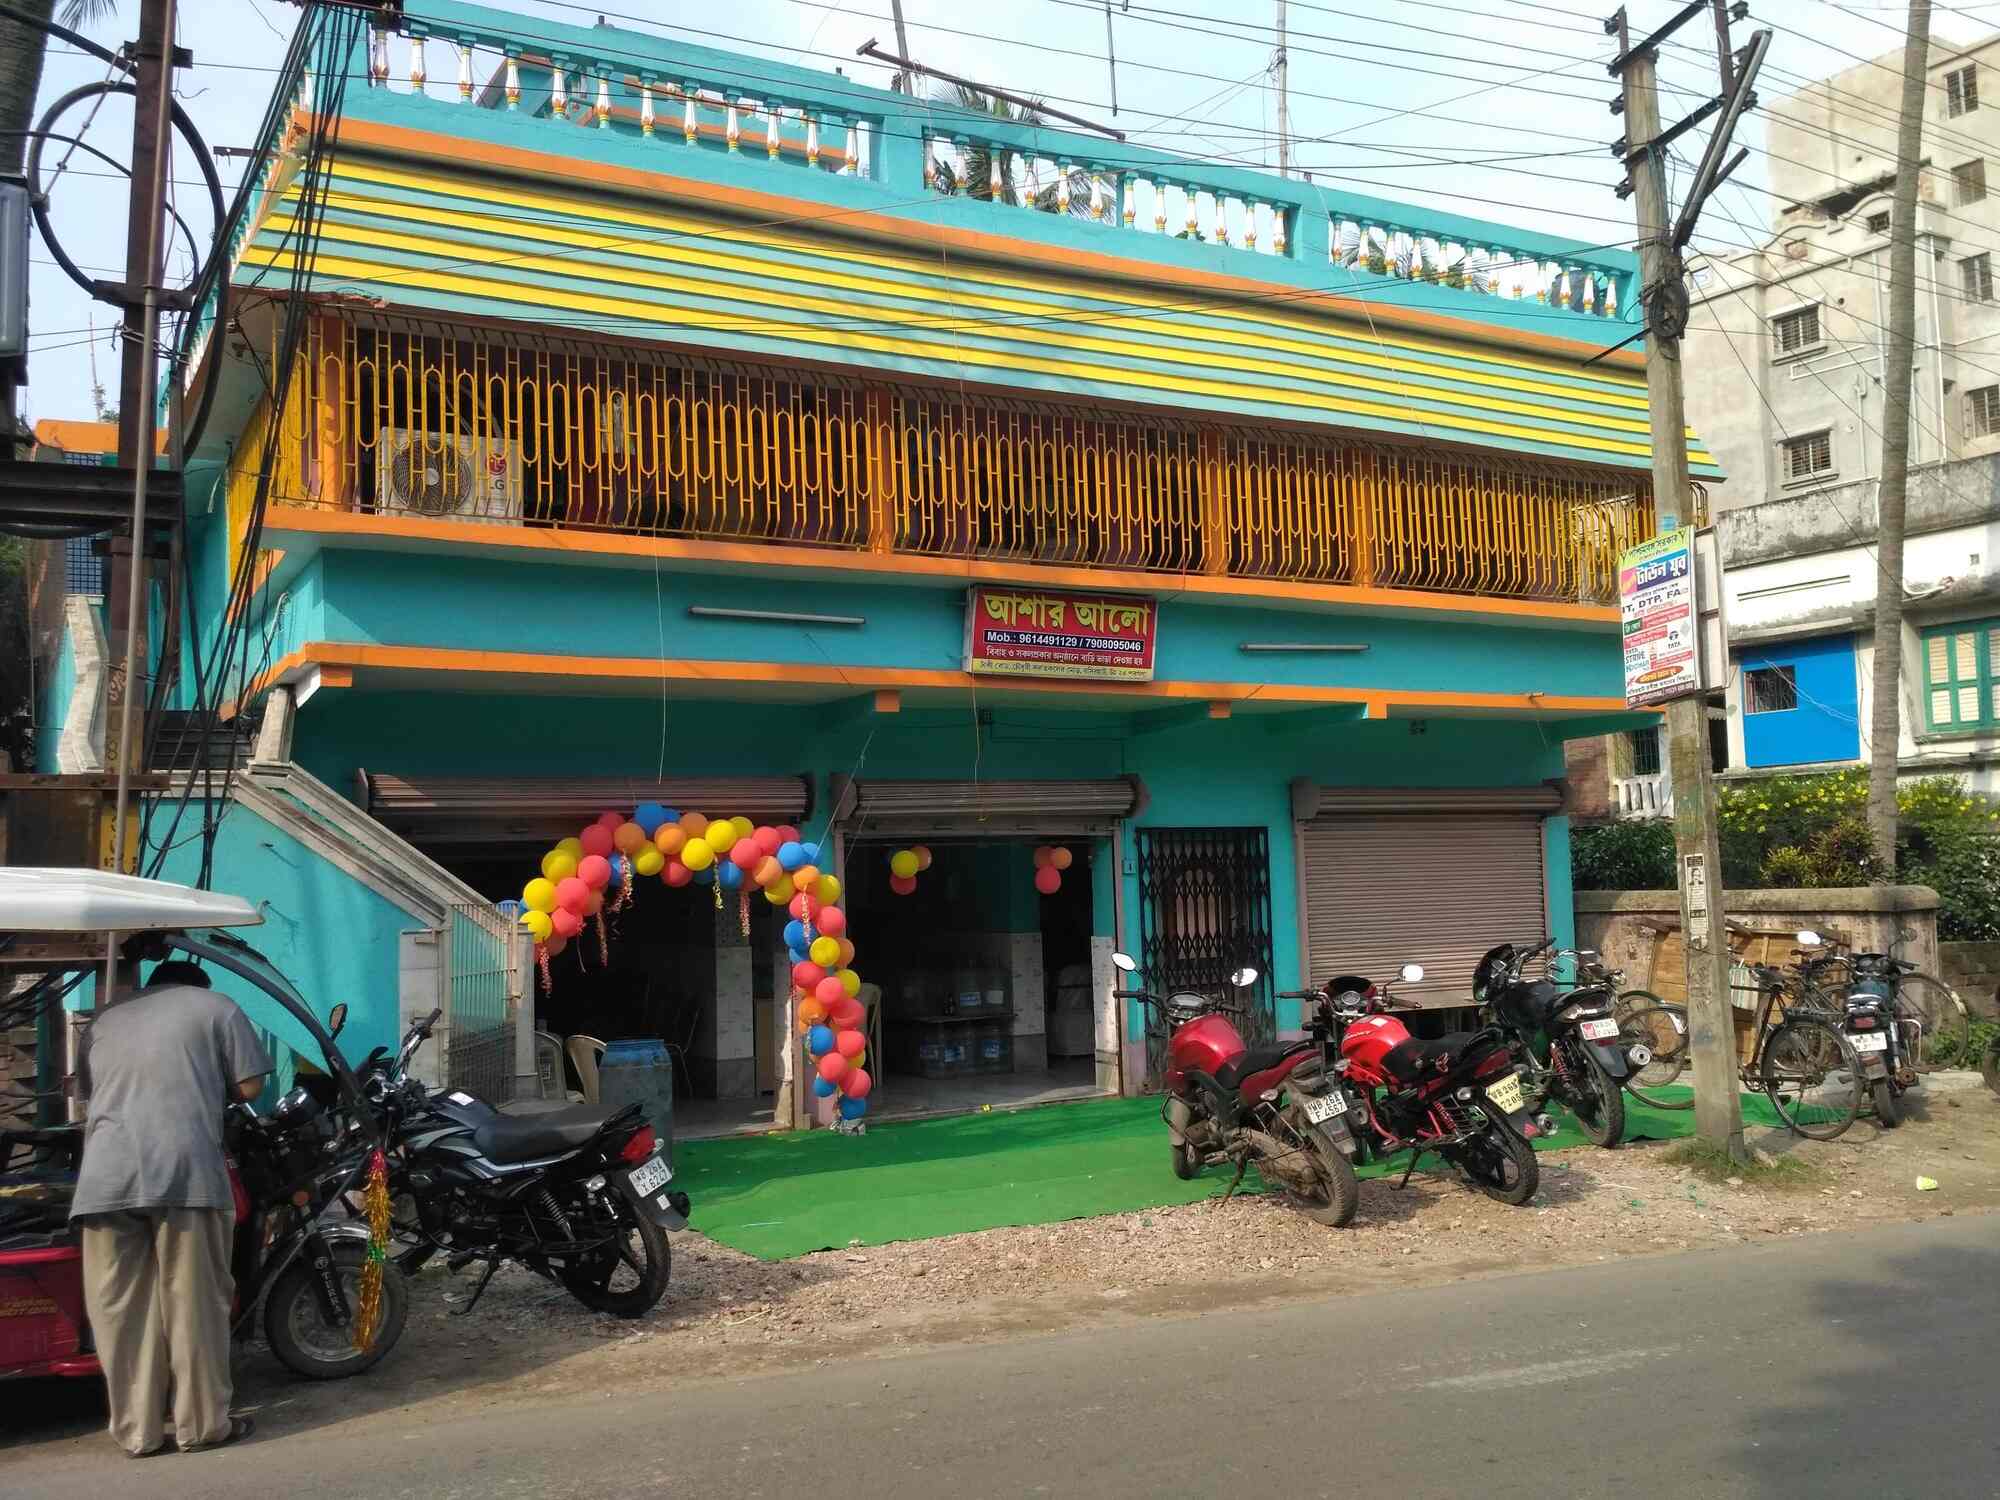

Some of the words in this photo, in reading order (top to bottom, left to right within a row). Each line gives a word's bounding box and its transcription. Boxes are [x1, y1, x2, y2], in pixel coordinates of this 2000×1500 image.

[1635, 561, 1667, 585] টাউন
[1670, 555, 1687, 577] যুব
[983, 592, 1066, 630] আশার
[1072, 600, 1152, 637] আলো
